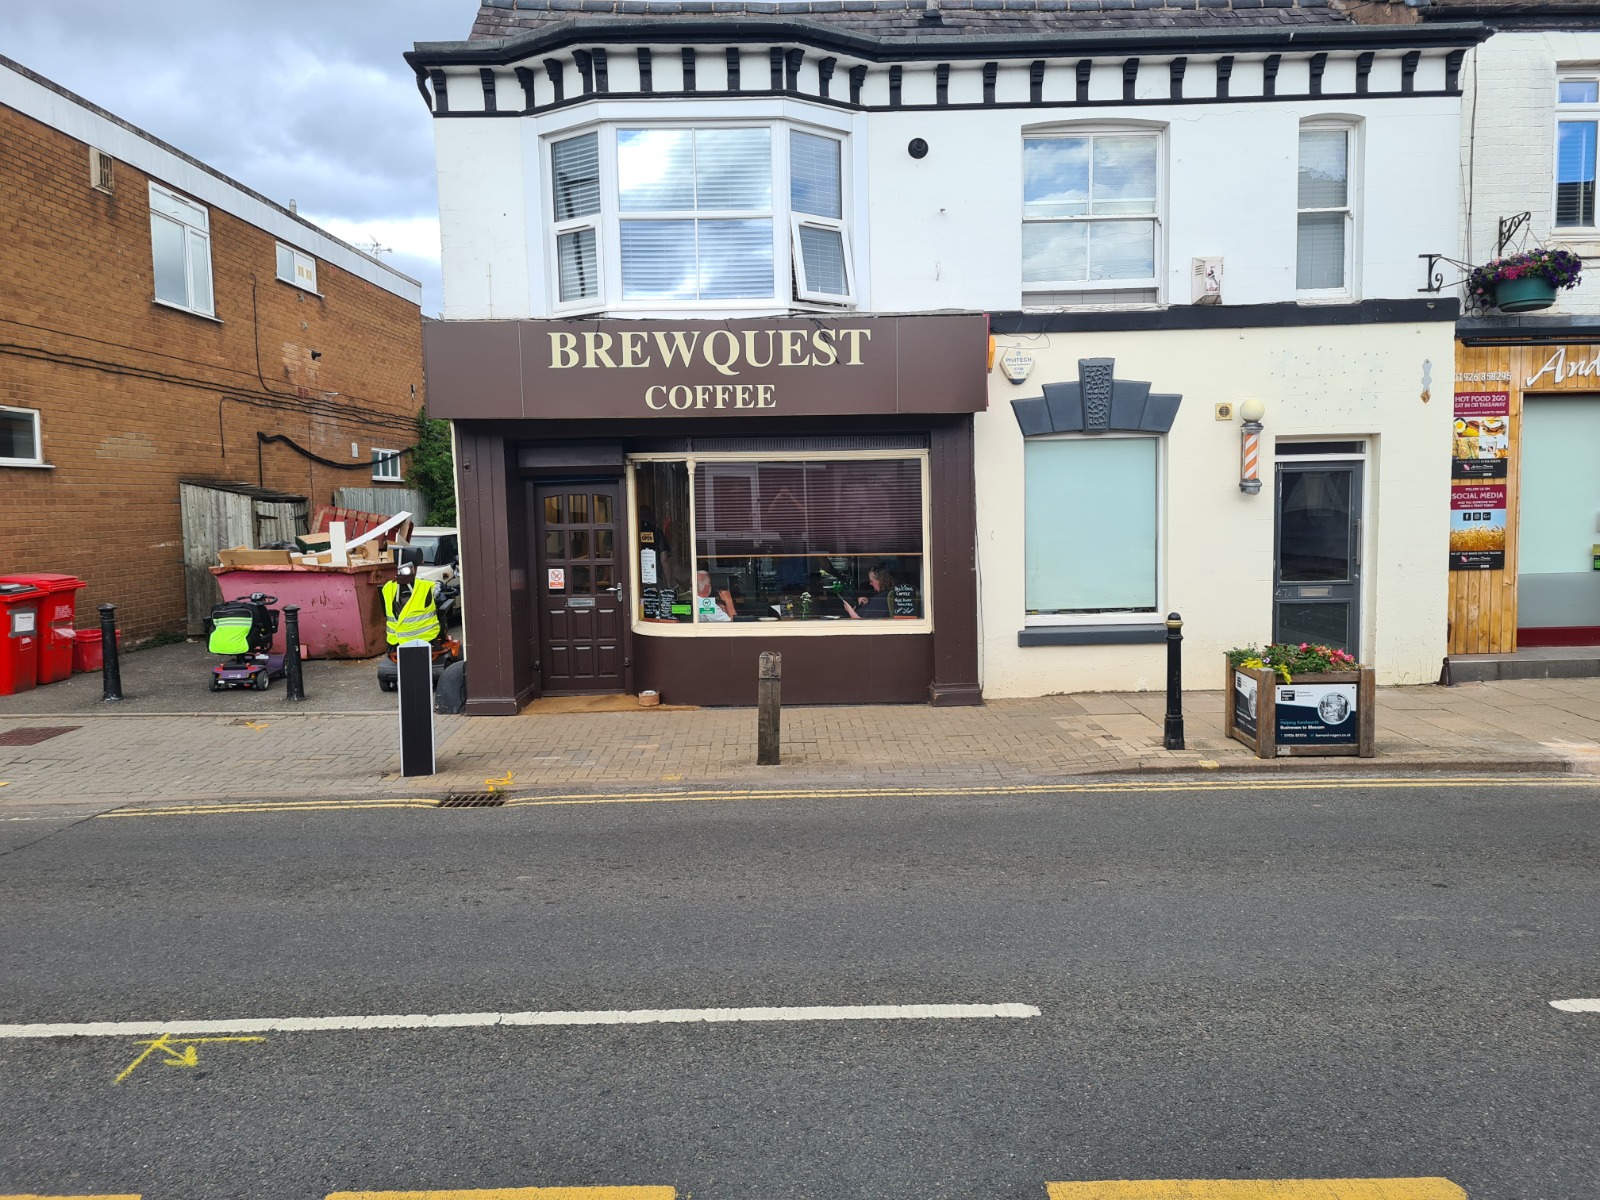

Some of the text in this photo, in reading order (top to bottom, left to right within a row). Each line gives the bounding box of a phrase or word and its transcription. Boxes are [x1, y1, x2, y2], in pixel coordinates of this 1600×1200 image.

[547, 328, 871, 375] BREWQUEST
[645, 384, 776, 410] COFFEE
[1491, 394, 1507, 402] 2GO
